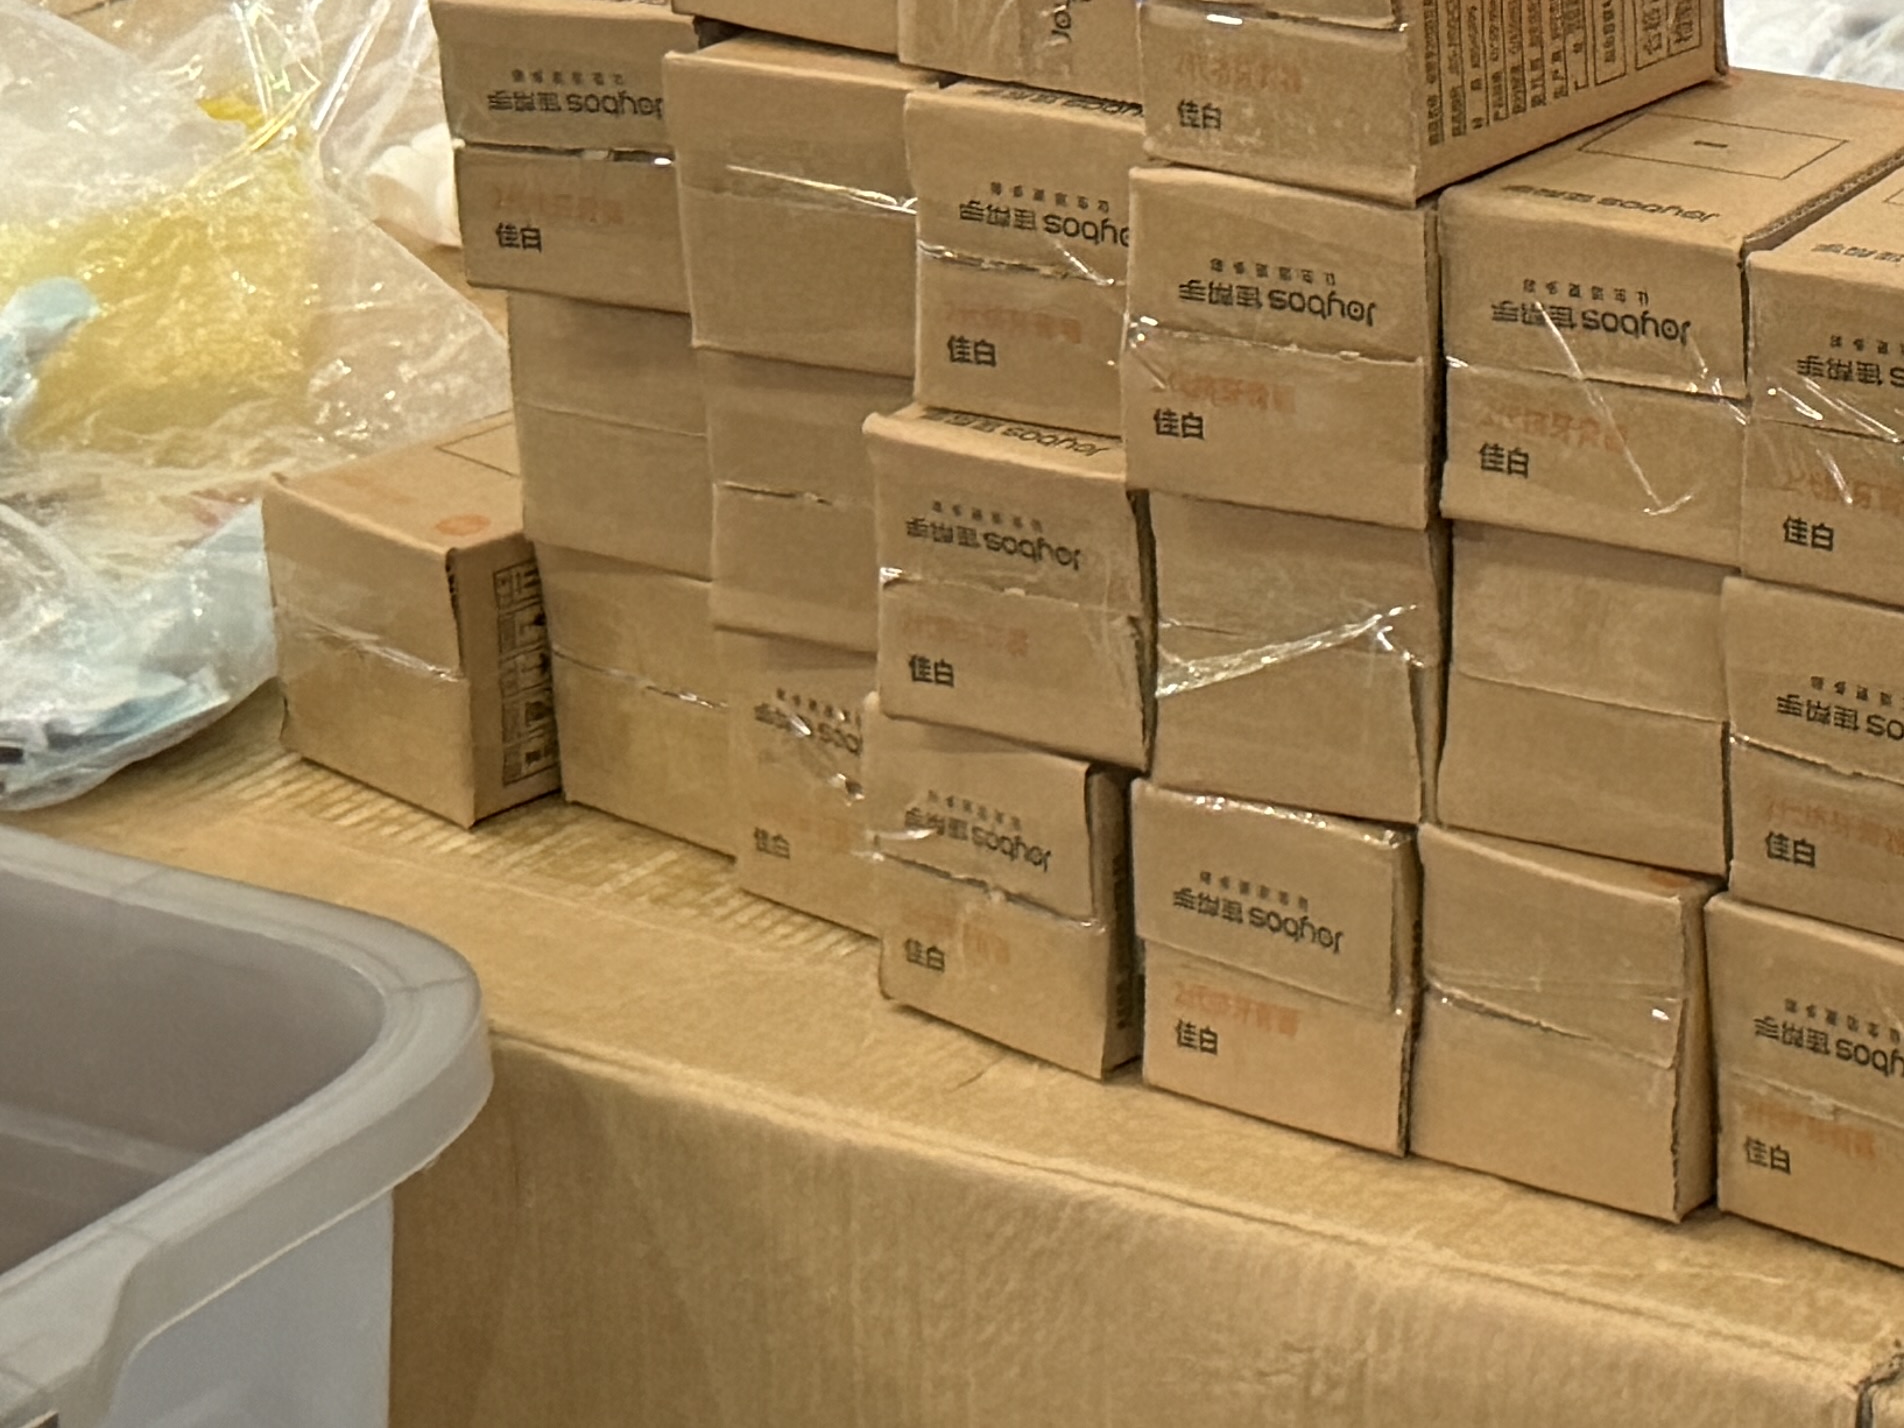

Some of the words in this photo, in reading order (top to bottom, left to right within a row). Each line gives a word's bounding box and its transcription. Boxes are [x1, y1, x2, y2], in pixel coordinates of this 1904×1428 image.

[1177, 99, 1222, 131] 佳白
[496, 222, 542, 252] 佳白
[1044, 213, 1130, 247] oybos
[1268, 290, 1378, 327] Joybos
[1581, 308, 1691, 344] Joybos
[947, 335, 996, 367] 佳白
[1153, 408, 1205, 440] 佳白
[1479, 442, 1529, 478] 佳白
[1783, 515, 1834, 552] 佳白
[908, 654, 954, 688] 佳白
[1765, 830, 1816, 868] 佳白
[1248, 905, 1344, 955] Joybos
[1175, 1019, 1219, 1056] 佳白
[1744, 1134, 1792, 1175] 佳白
